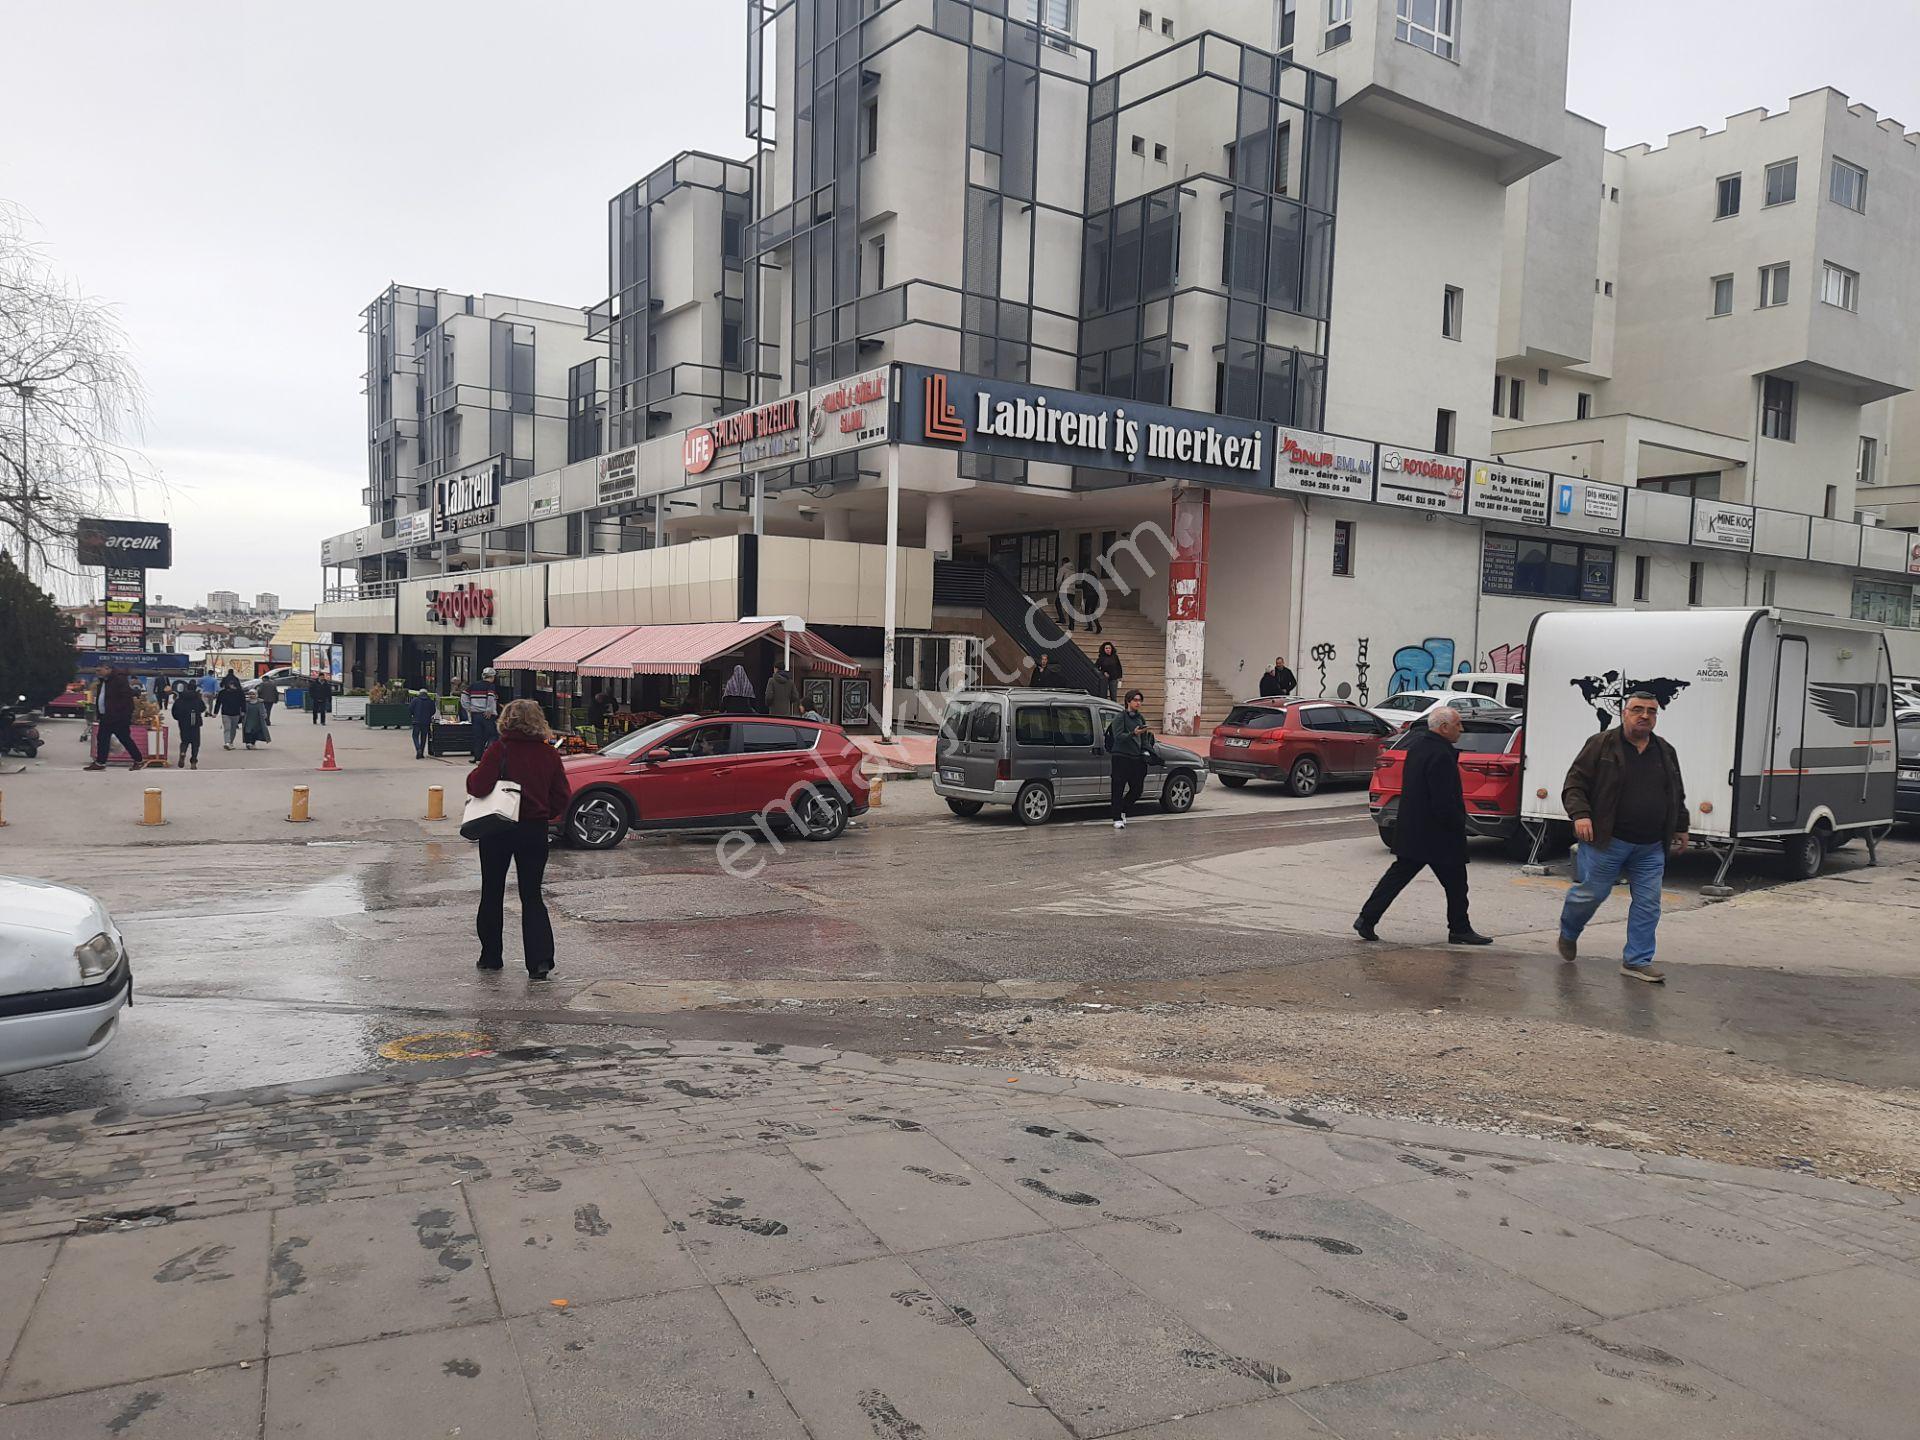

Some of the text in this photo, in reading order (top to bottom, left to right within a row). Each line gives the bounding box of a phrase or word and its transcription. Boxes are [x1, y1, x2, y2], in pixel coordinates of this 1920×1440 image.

[977, 391, 1262, 471] Labirent iş merkezi
[685, 434, 709, 465] LIFE
[1289, 467, 1309, 476] arsa
[1316, 470, 1338, 480] daire
[1345, 475, 1362, 484] villa
[1403, 458, 1465, 486] FOTOĞRAFÇI
[1490, 472, 1507, 485] DİŞ
[1511, 477, 1545, 490] HEKİMİ
[445, 464, 493, 516] Labirent
[105, 536, 161, 551] arçelik
[107, 567, 141, 578] ZAFER
[110, 636, 140, 645] Optik
